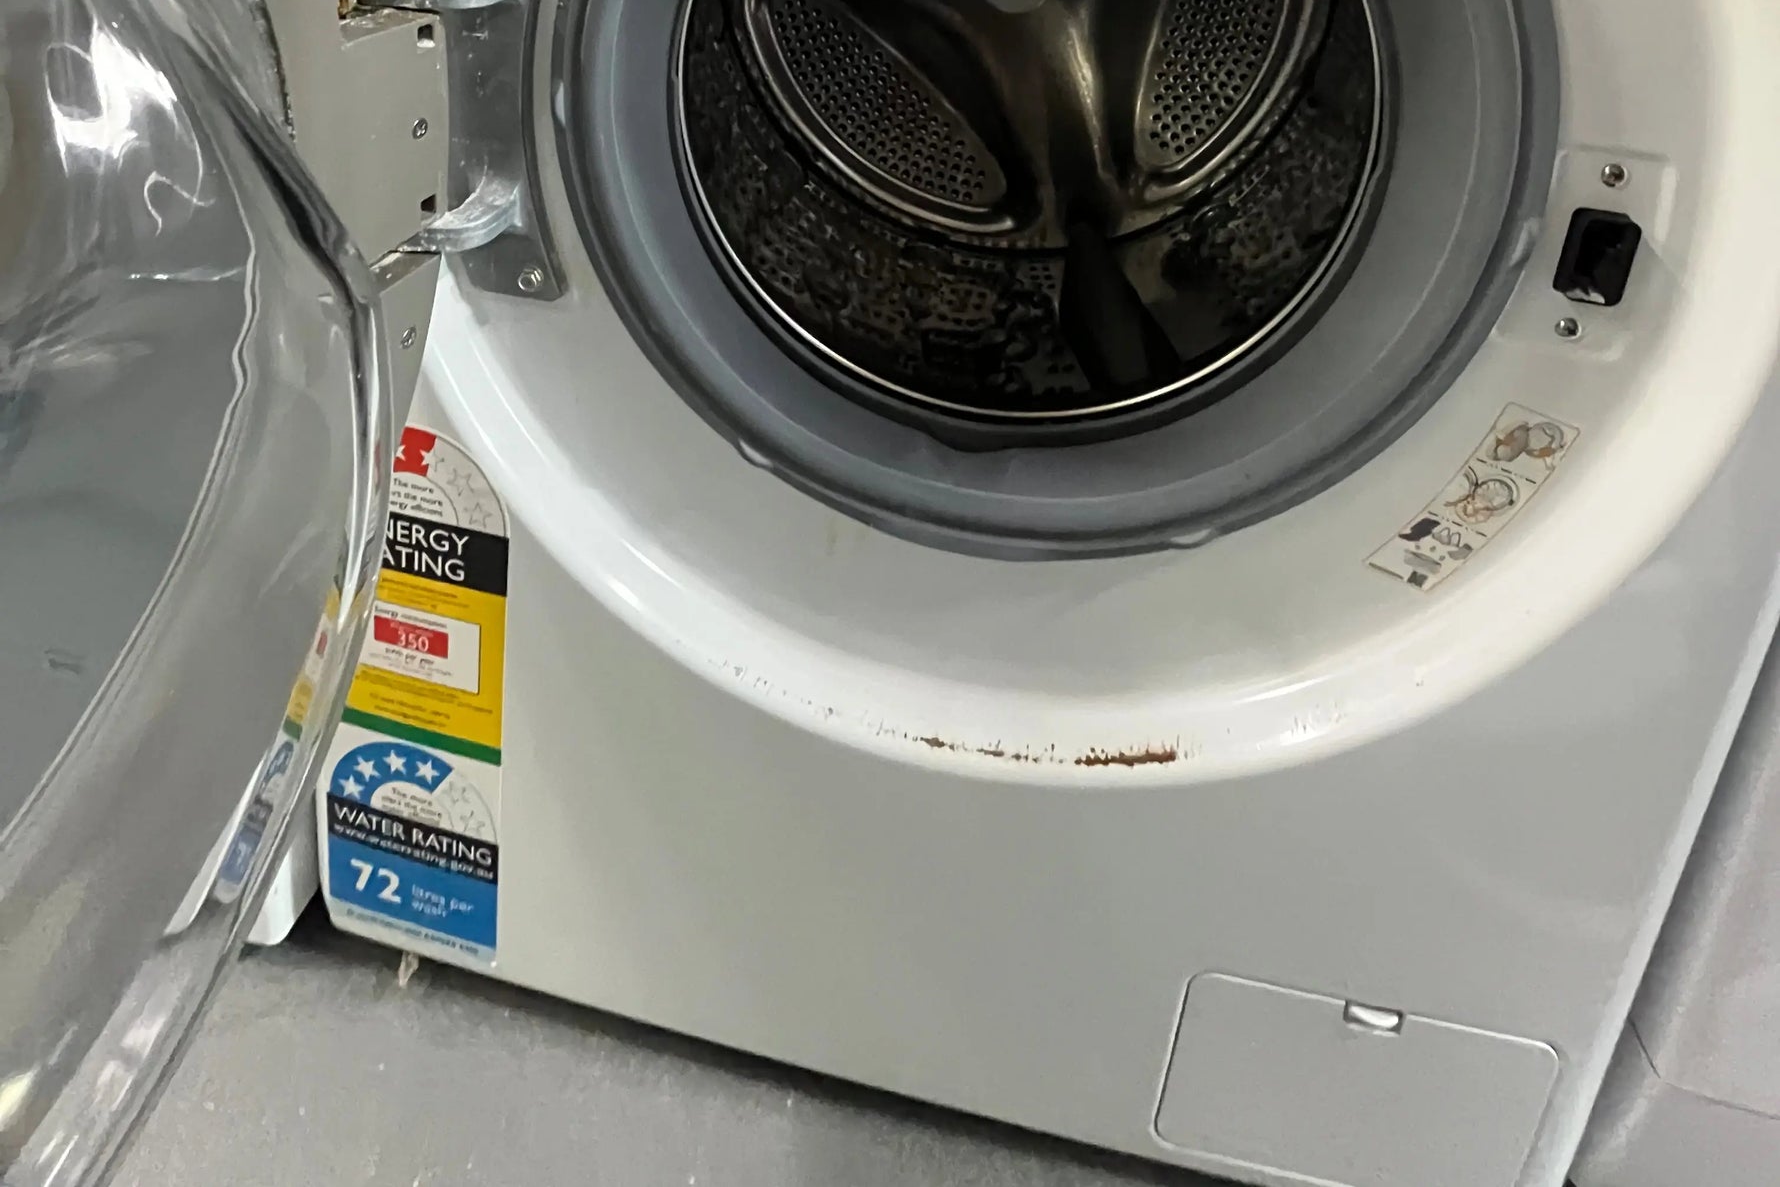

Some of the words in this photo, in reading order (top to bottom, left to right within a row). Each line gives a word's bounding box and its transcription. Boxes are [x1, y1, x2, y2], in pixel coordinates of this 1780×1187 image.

[382, 543, 465, 582] ATING
[397, 629, 430, 653] 350
[333, 802, 406, 841] WATER
[411, 827, 492, 866] RATING
[350, 857, 402, 906] 72
